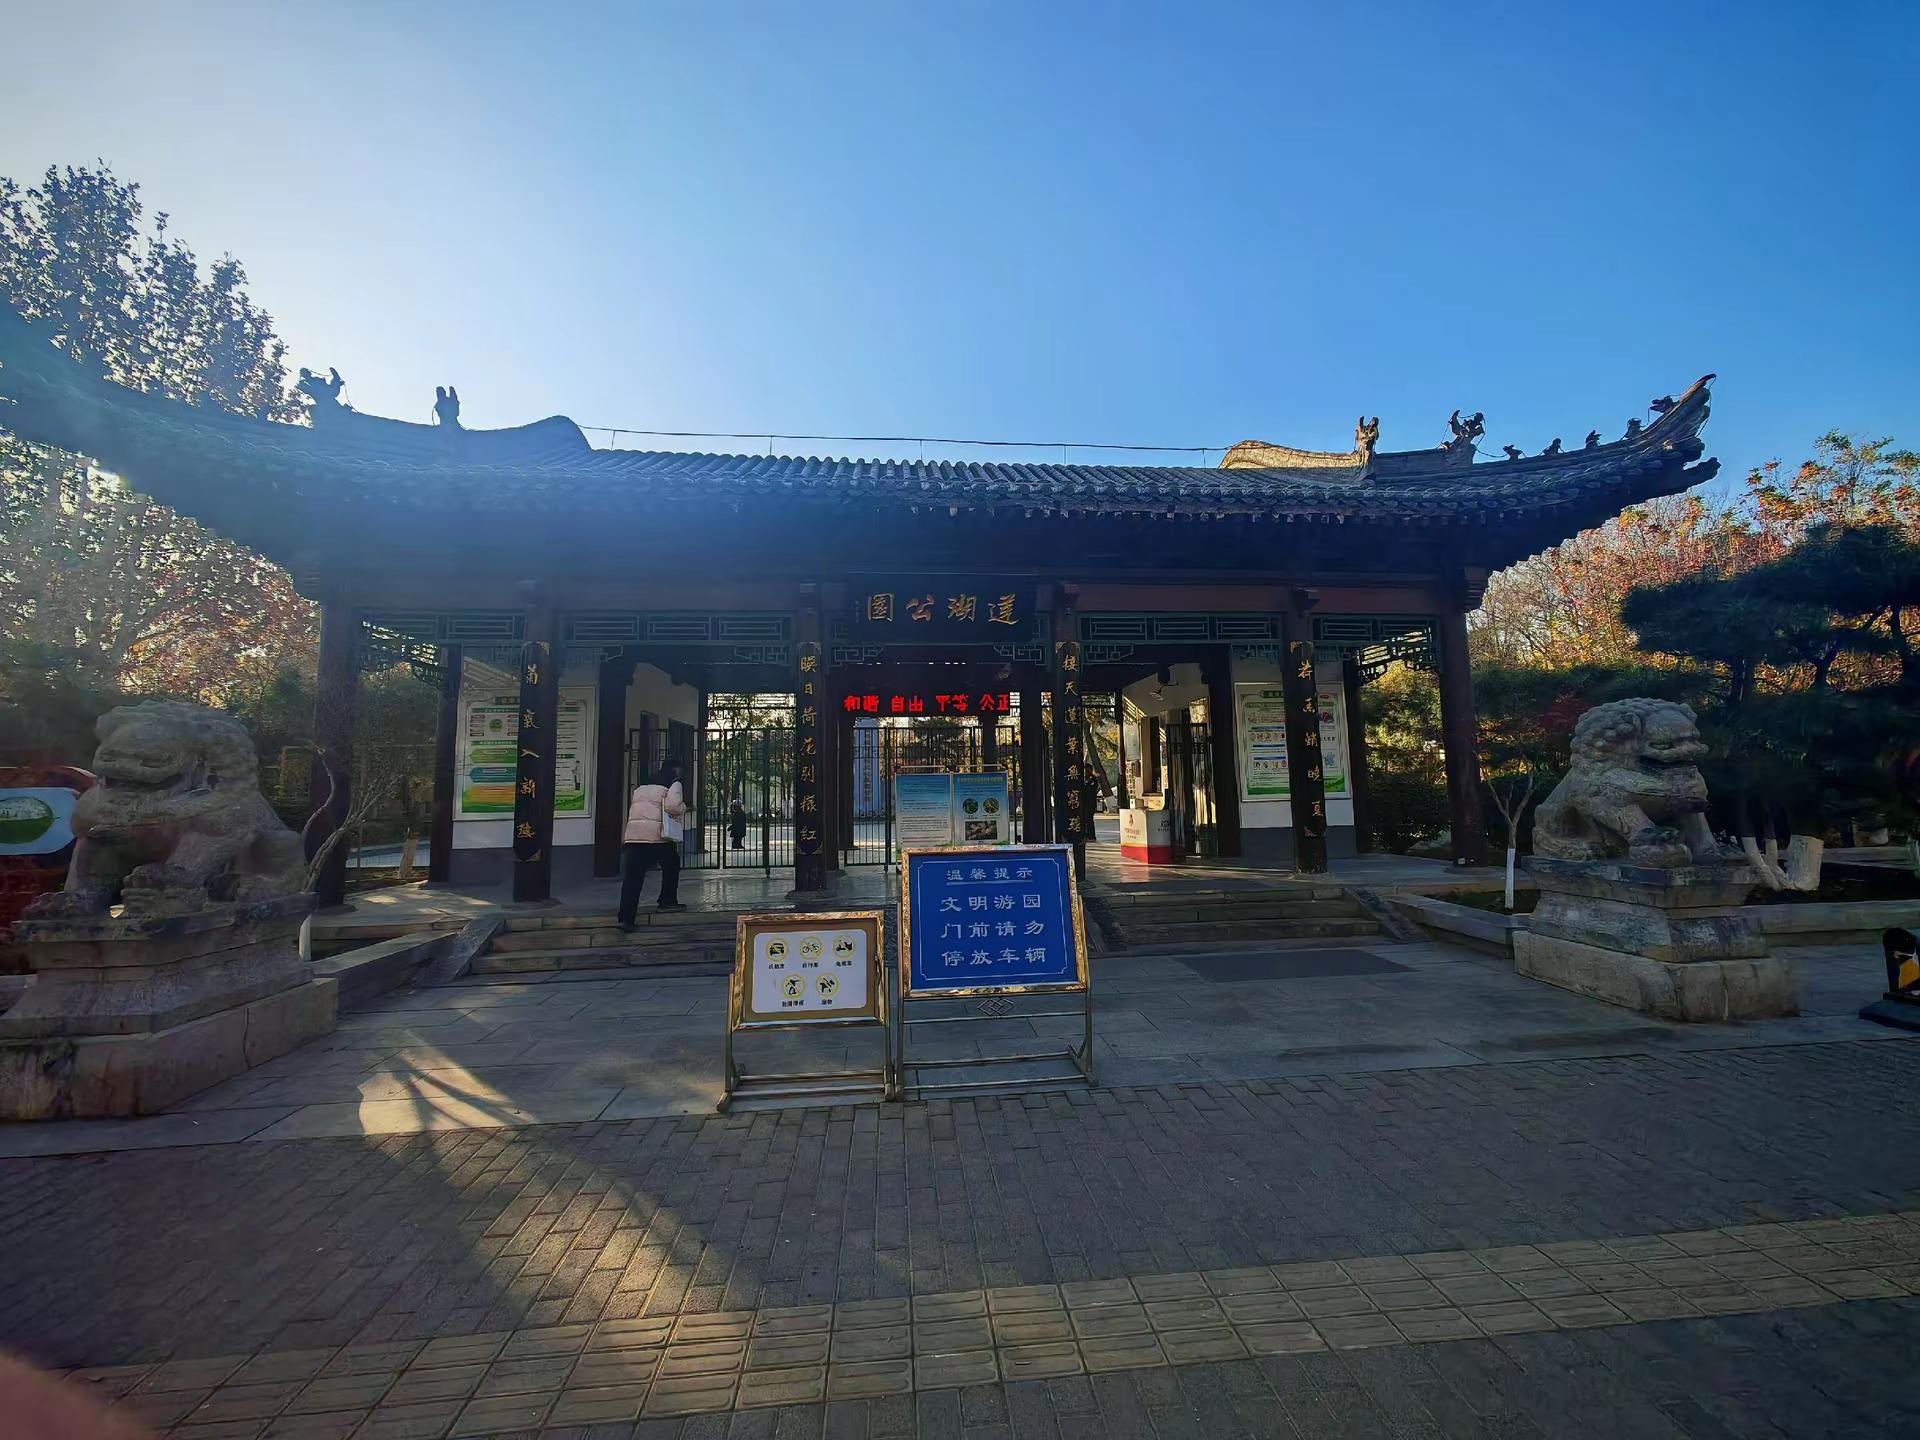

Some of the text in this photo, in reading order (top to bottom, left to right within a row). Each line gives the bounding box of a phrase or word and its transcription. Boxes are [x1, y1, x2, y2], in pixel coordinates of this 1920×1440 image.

[979, 694, 1010, 711] 公正
[946, 867, 1033, 881] 温馨提示
[939, 894, 1041, 912] 文明游园
[940, 920, 1045, 939] 门前请勿
[941, 947, 1046, 967] 停放车辆
